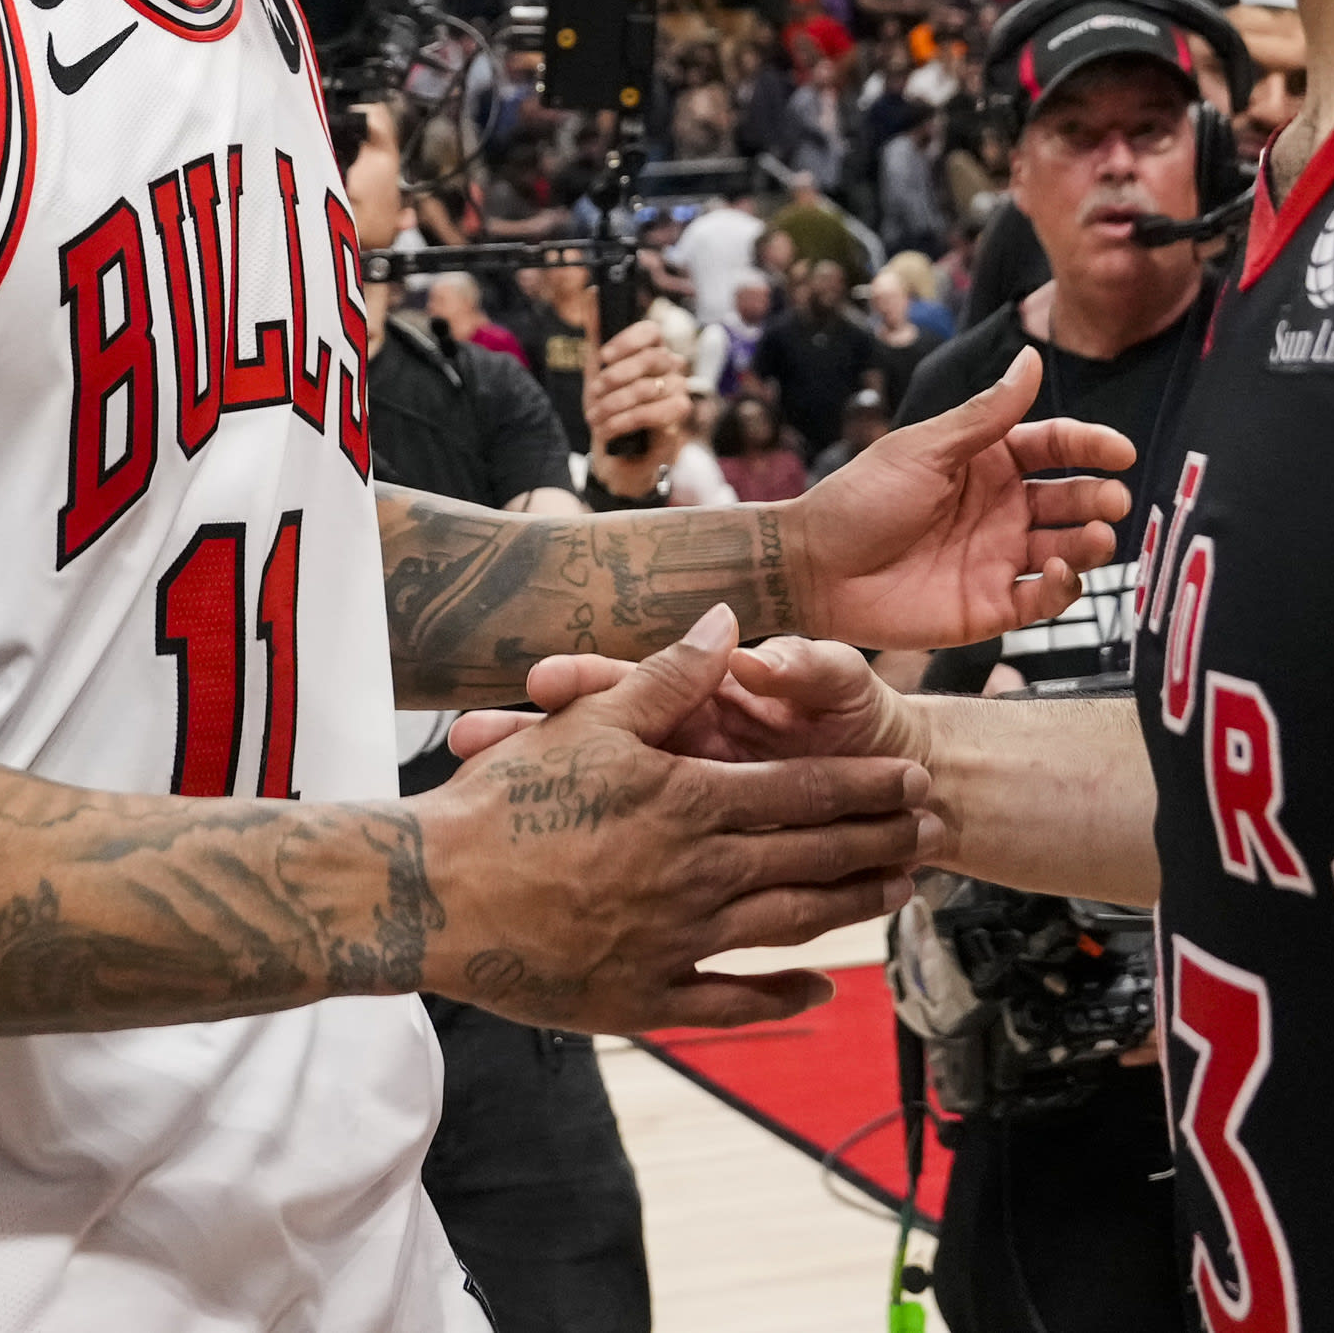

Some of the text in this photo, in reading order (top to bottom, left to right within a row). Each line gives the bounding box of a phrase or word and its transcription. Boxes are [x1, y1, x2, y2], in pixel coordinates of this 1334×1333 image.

[56, 144, 370, 572] BULLS
[1269, 319, 1314, 364] Sun
[155, 509, 303, 800] 11
[1155, 917, 1302, 1333] 3
